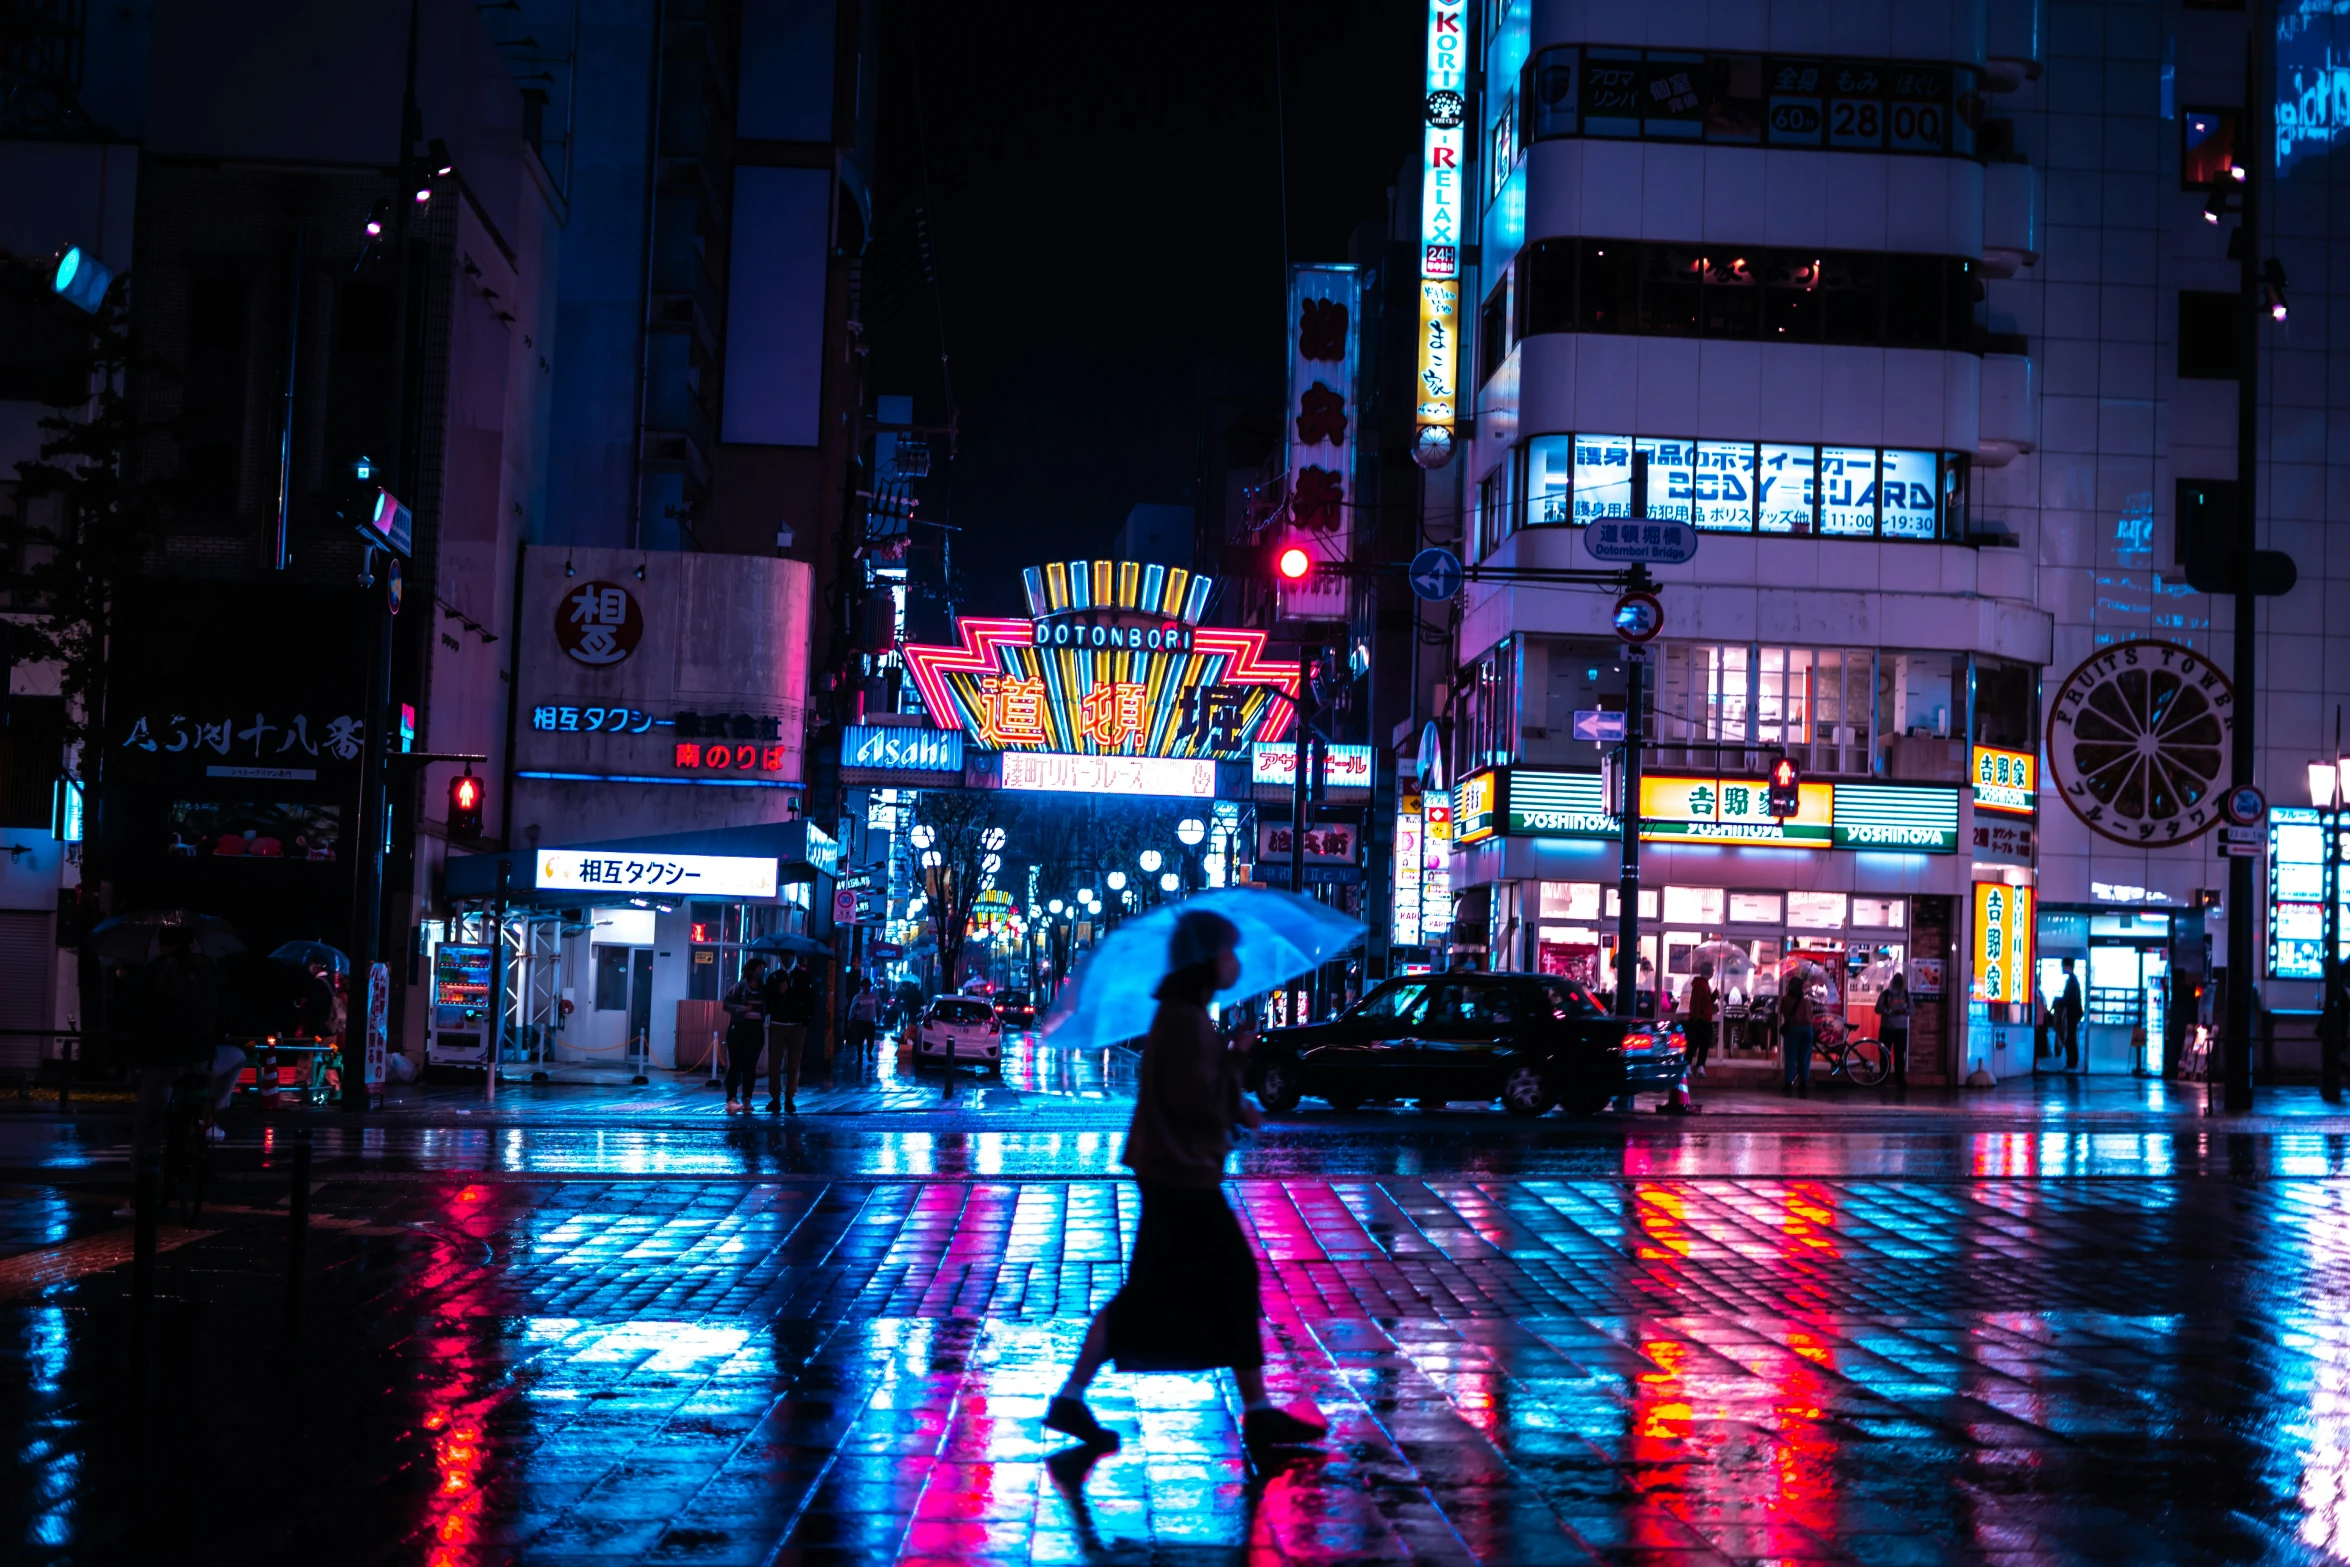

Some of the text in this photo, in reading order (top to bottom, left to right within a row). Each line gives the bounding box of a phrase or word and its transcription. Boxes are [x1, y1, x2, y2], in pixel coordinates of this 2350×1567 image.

[1588, 69, 1635, 87] アロマ
[1428, 247, 1454, 262] 24H
[1600, 524, 1682, 546] 道頓堀橋
[1596, 544, 1685, 559] Dotombori Bridge
[1036, 622, 1190, 650] DOTONBORI
[979, 673, 1244, 751] 道頓堀
[675, 742, 785, 771] 南のりば
[857, 730, 948, 766] Asahi
[1981, 755, 2026, 787] 吉野家
[1847, 826, 1944, 846] YOSHINOYA
[579, 858, 701, 886] 相互タクシー
[1985, 889, 2003, 998] 吉野家
